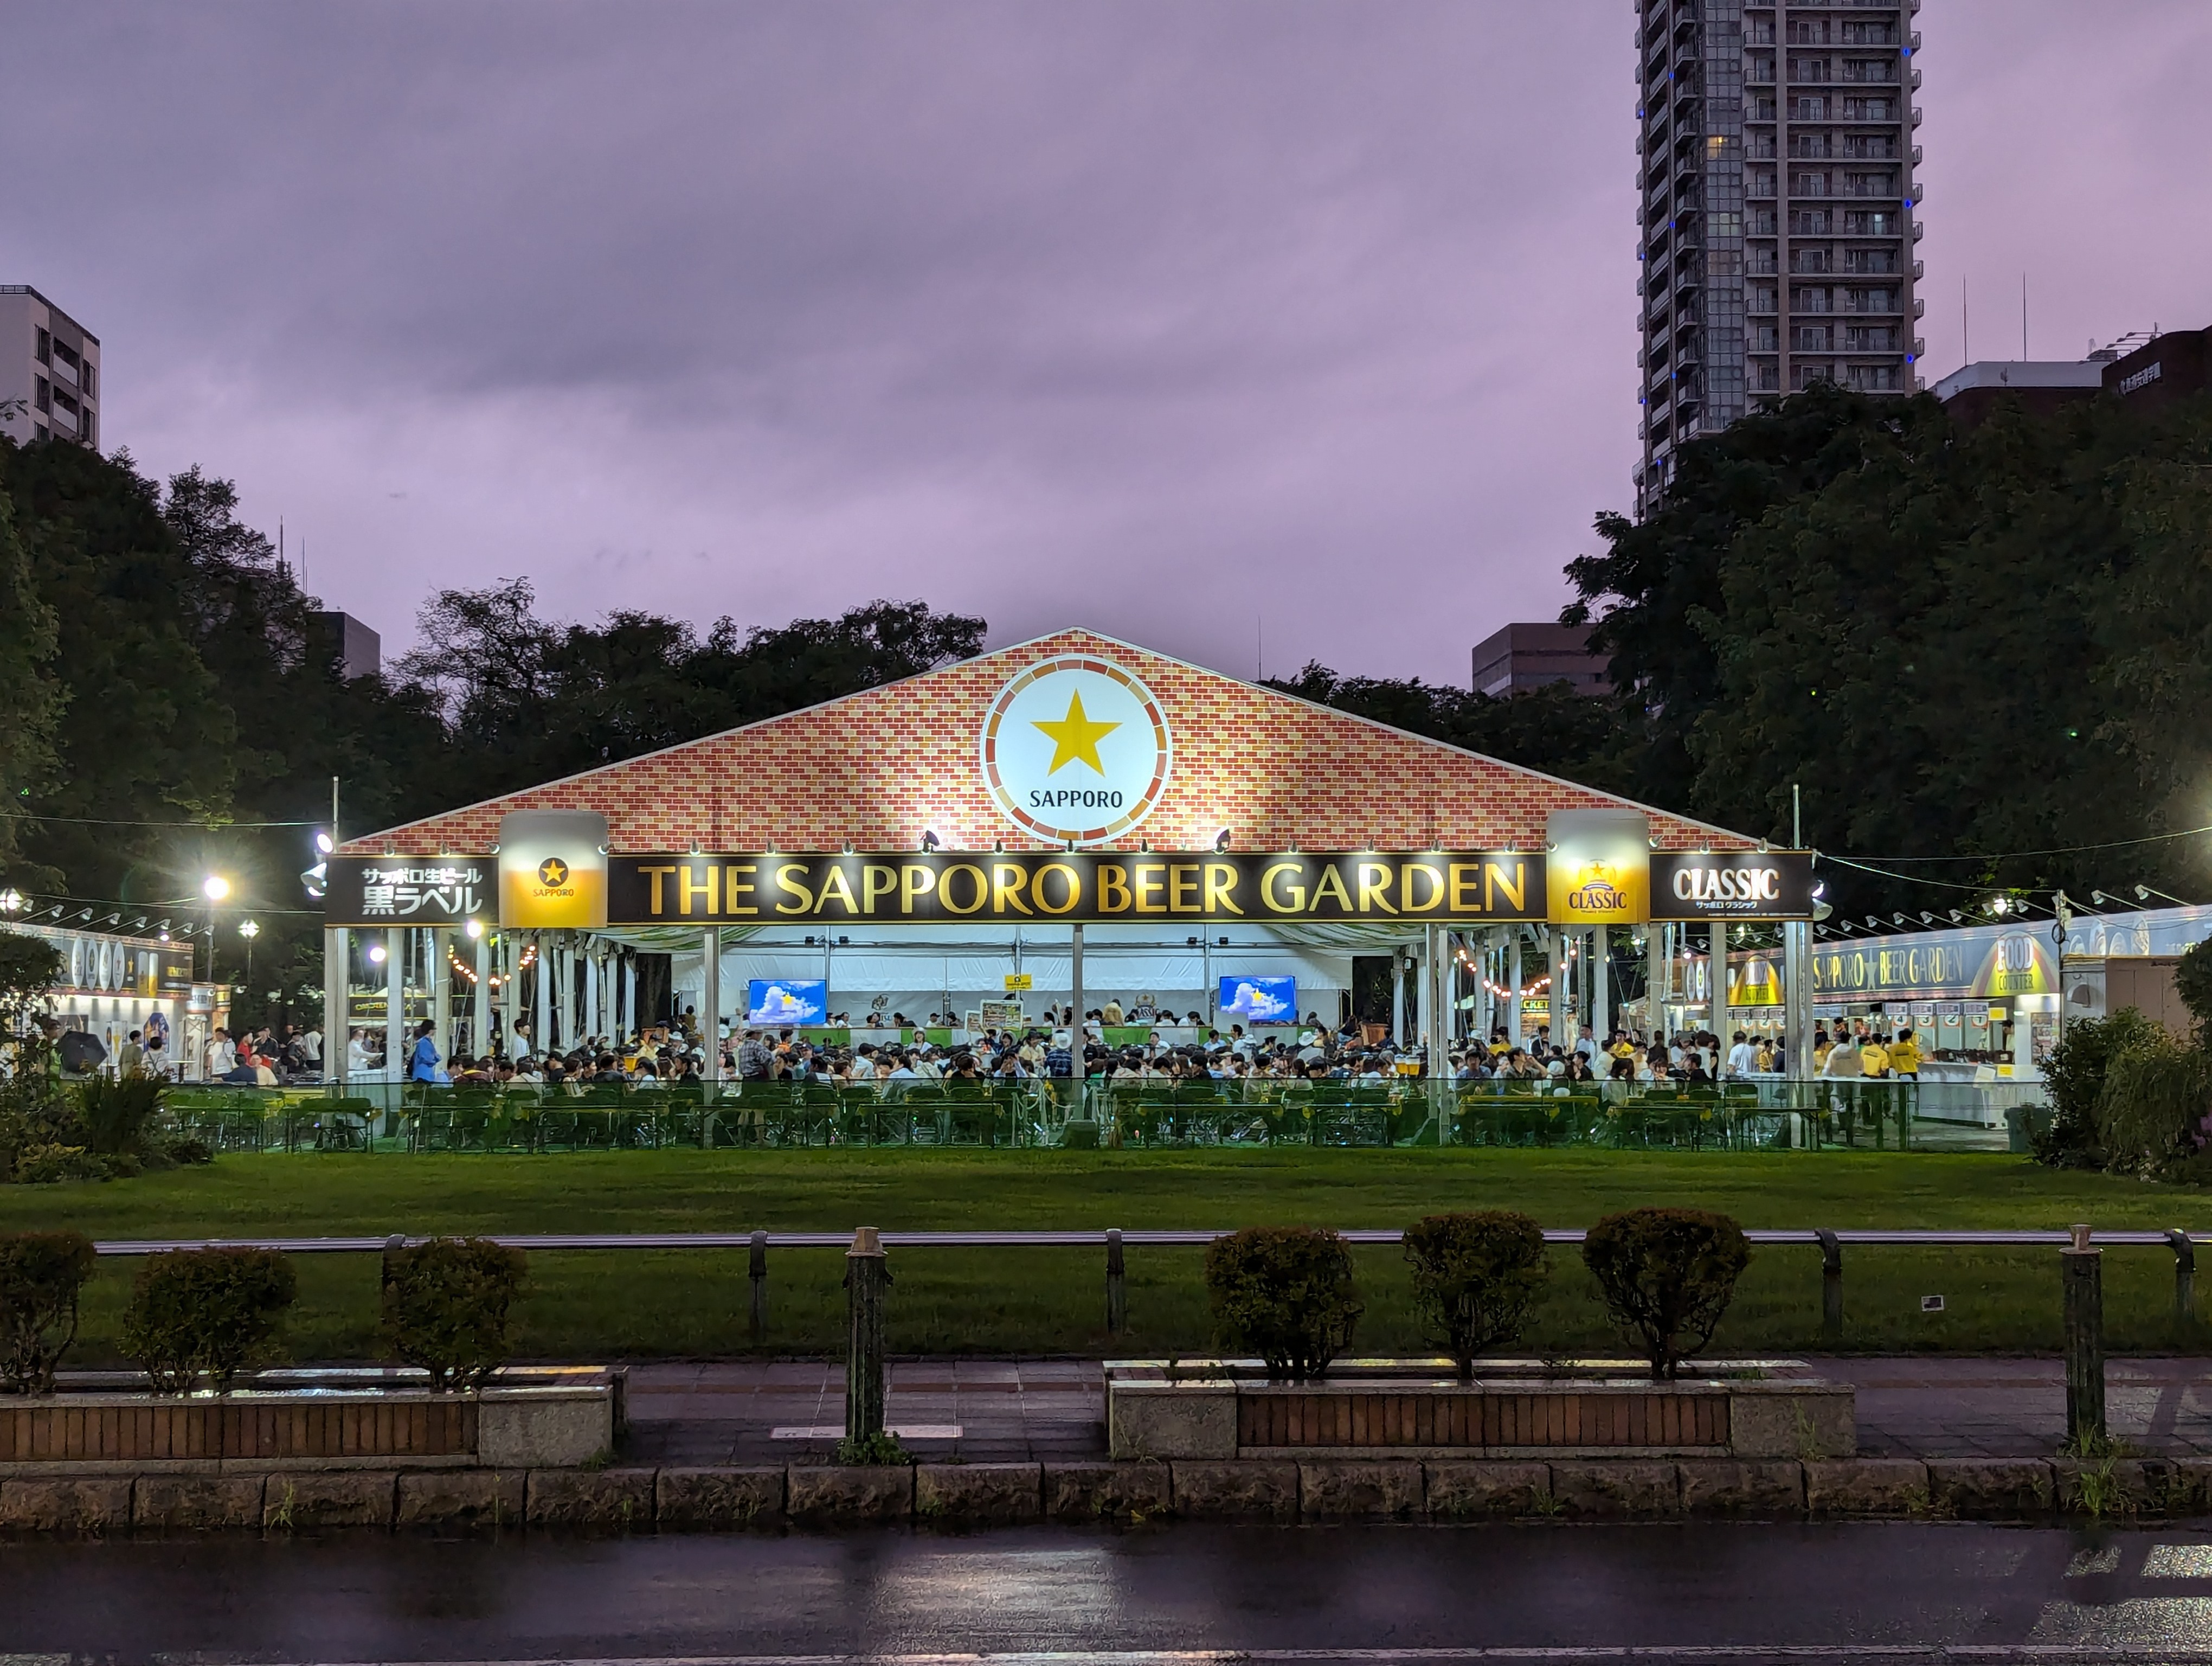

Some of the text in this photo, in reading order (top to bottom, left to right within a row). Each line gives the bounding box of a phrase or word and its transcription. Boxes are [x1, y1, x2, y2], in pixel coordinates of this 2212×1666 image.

[1030, 790, 1122, 808] SAPPORO
[361, 868, 483, 884] サッポロ生ビール
[1673, 868, 1779, 900] CLASSIC
[362, 885, 483, 915] 黒ラベル
[638, 863, 1525, 915] THE SAPPORO BEER GARDEN
[1569, 892, 1626, 908] CLASSIC
[1997, 937, 2034, 971] FOOD
[1814, 945, 1963, 989] SAPPORO BEER GARDEN
[1999, 974, 2034, 990] COUNTER
[1948, 1015, 1956, 1023] 2
